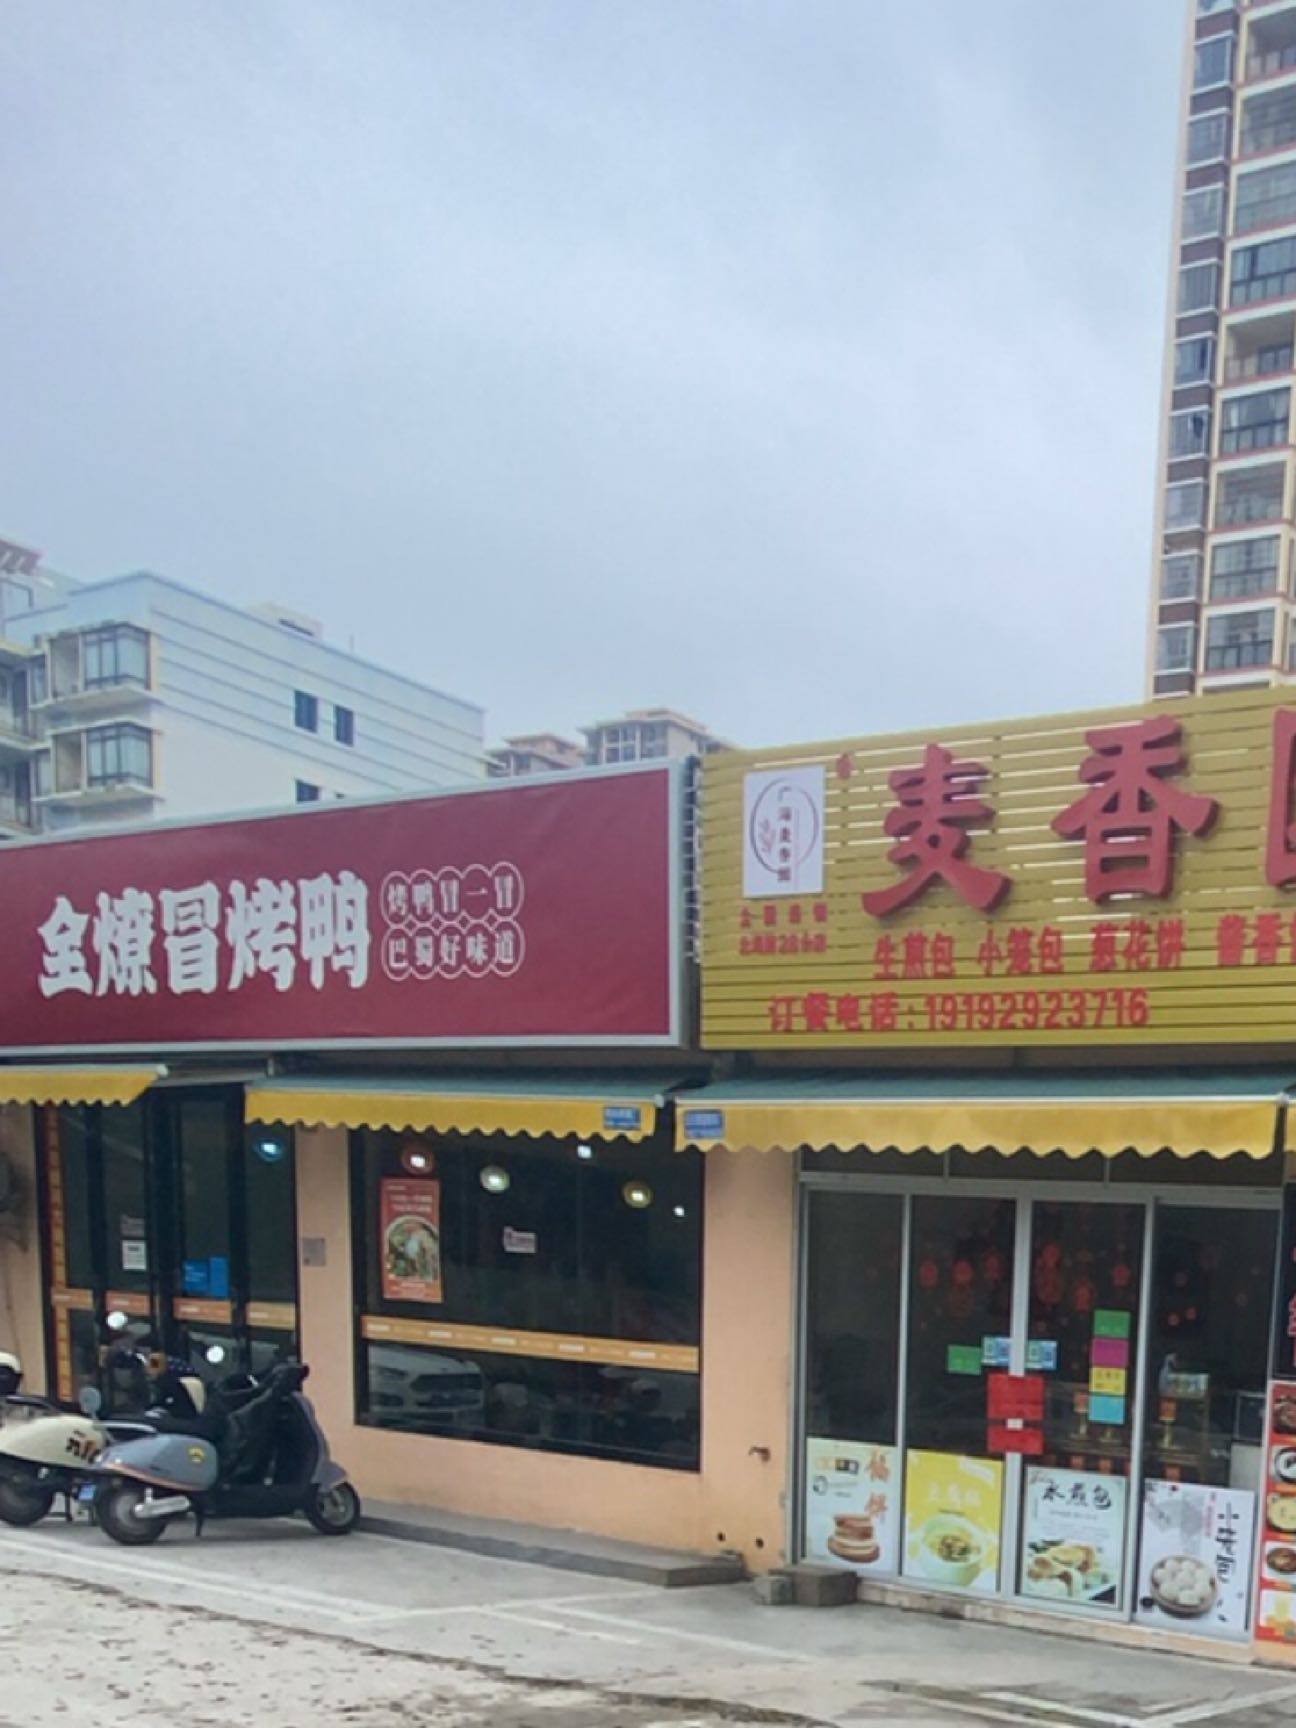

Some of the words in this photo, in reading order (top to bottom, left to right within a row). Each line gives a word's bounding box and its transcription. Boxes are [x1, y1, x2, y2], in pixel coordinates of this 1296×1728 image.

[388, 929, 514, 969] 巴蜀好味道
[874, 932, 957, 979] 生煎包
[977, 925, 1064, 974] 小笼包
